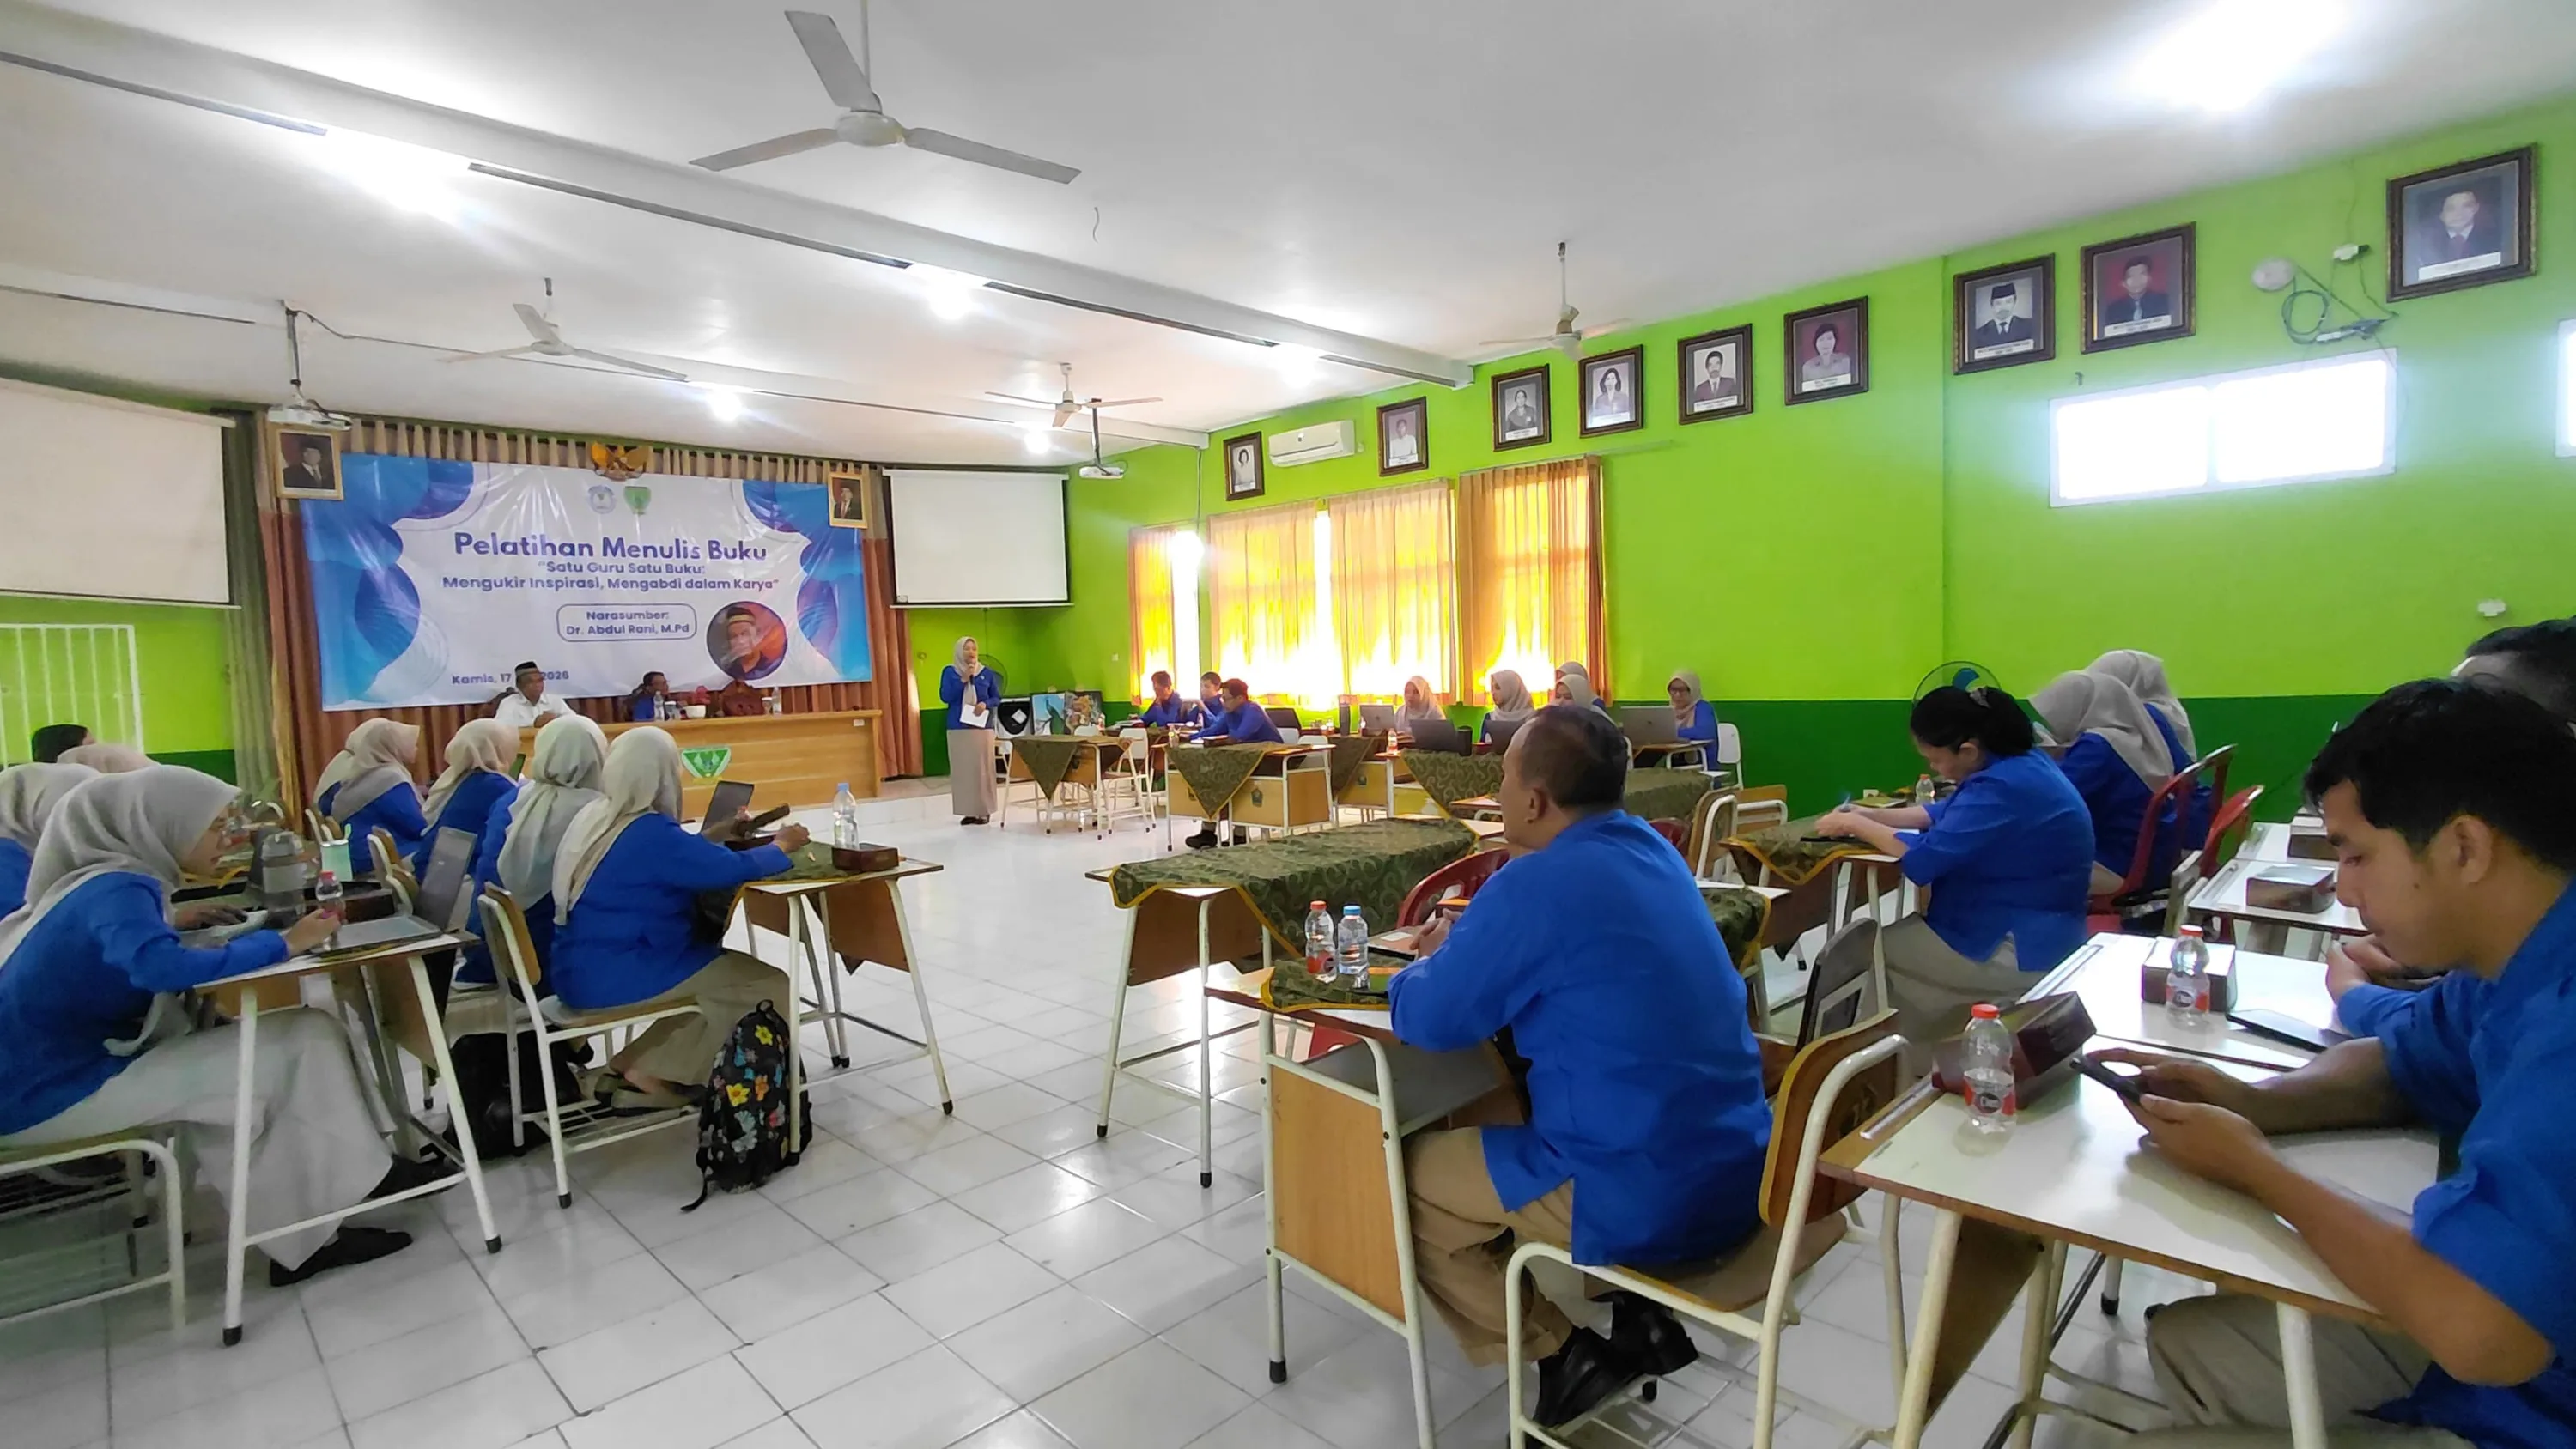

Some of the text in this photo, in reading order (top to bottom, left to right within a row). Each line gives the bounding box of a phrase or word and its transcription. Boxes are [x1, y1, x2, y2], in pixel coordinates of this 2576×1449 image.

[454, 532, 767, 561] Pelatihan Menulis Buku
[586, 561, 624, 573] Guru
[629, 563, 662, 574] Satu
[442, 576, 526, 591] Mengukir
[530, 576, 605, 592] Inspirasi,
[607, 578, 682, 592] Mengabdi
[685, 578, 731, 590] dalam
[566, 625, 585, 635] Dr.
[587, 625, 625, 634] Abdul
[660, 623, 690, 634] M.Pd
[500, 673, 512, 683] 17
